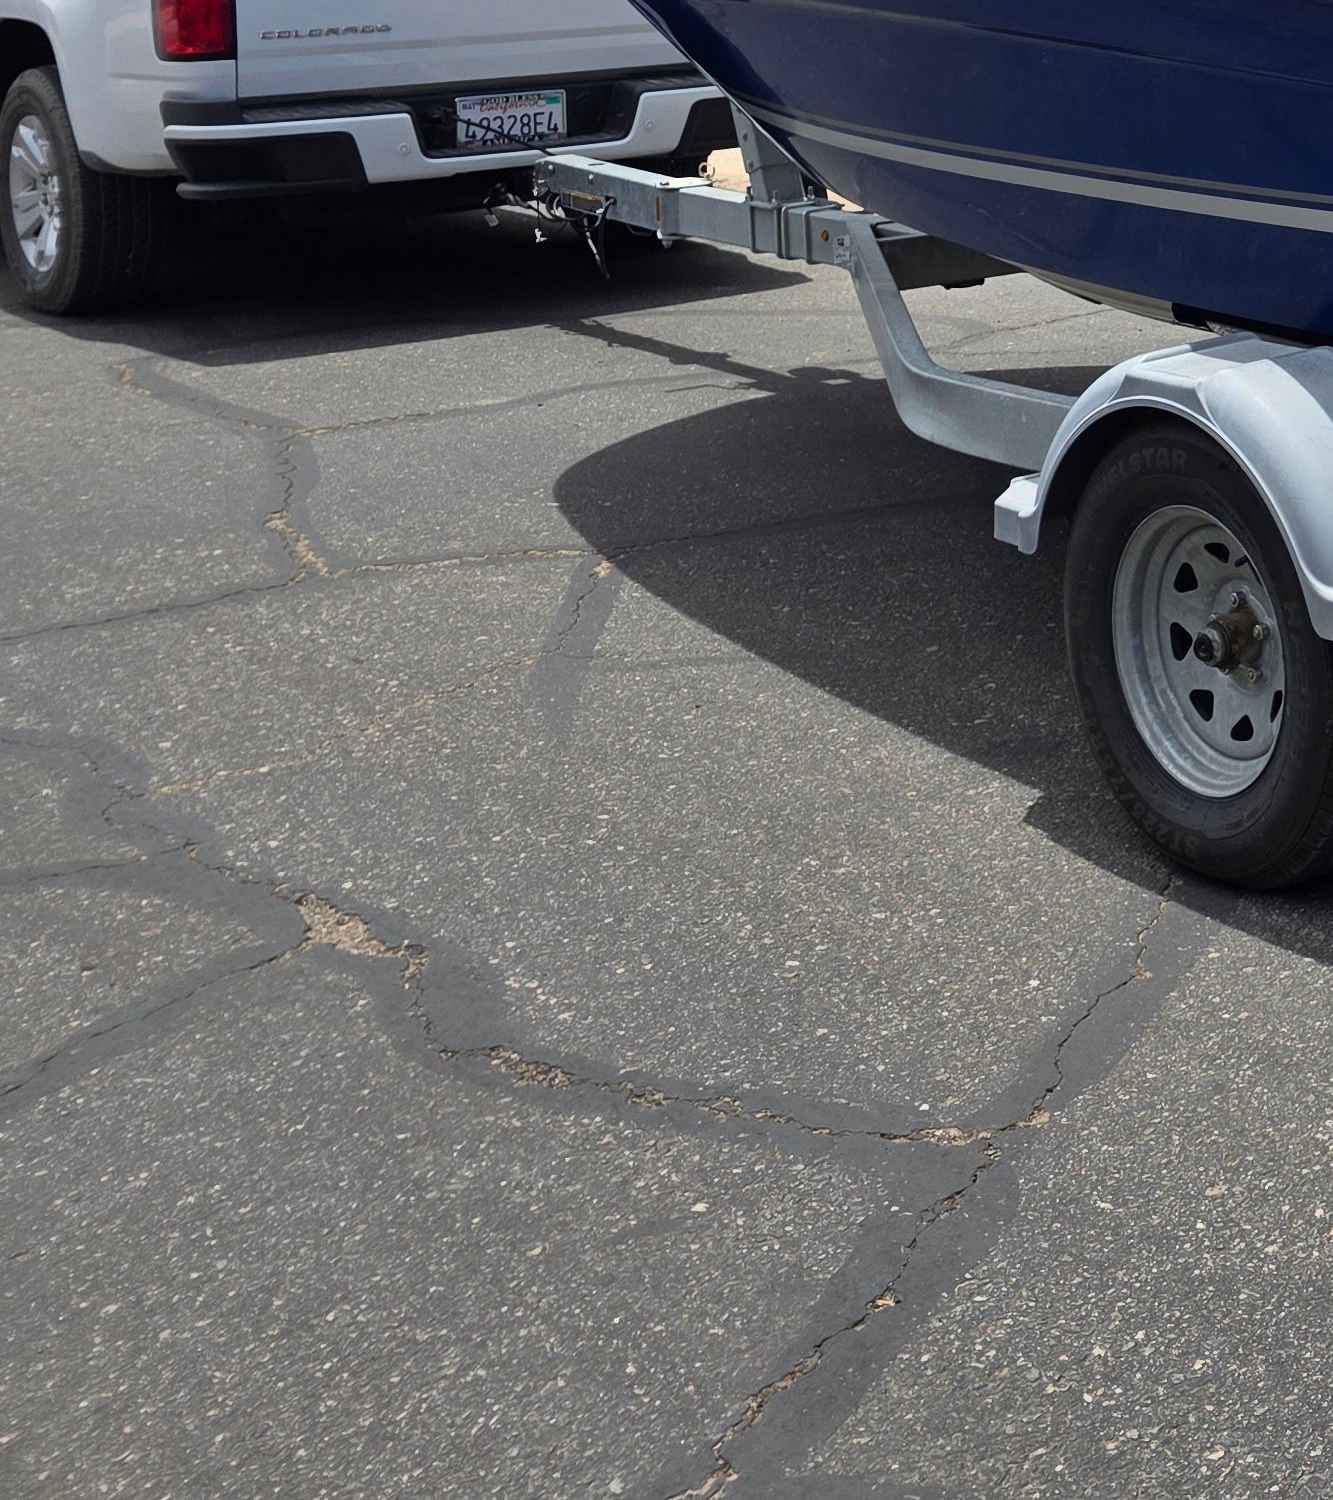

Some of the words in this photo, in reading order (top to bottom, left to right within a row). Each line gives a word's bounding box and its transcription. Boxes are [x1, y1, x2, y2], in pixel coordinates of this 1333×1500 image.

[259, 23, 393, 40] COLORADO
[461, 101, 476, 111] MAY
[480, 99, 540, 115] California
[465, 111, 560, 141] 49328E4
